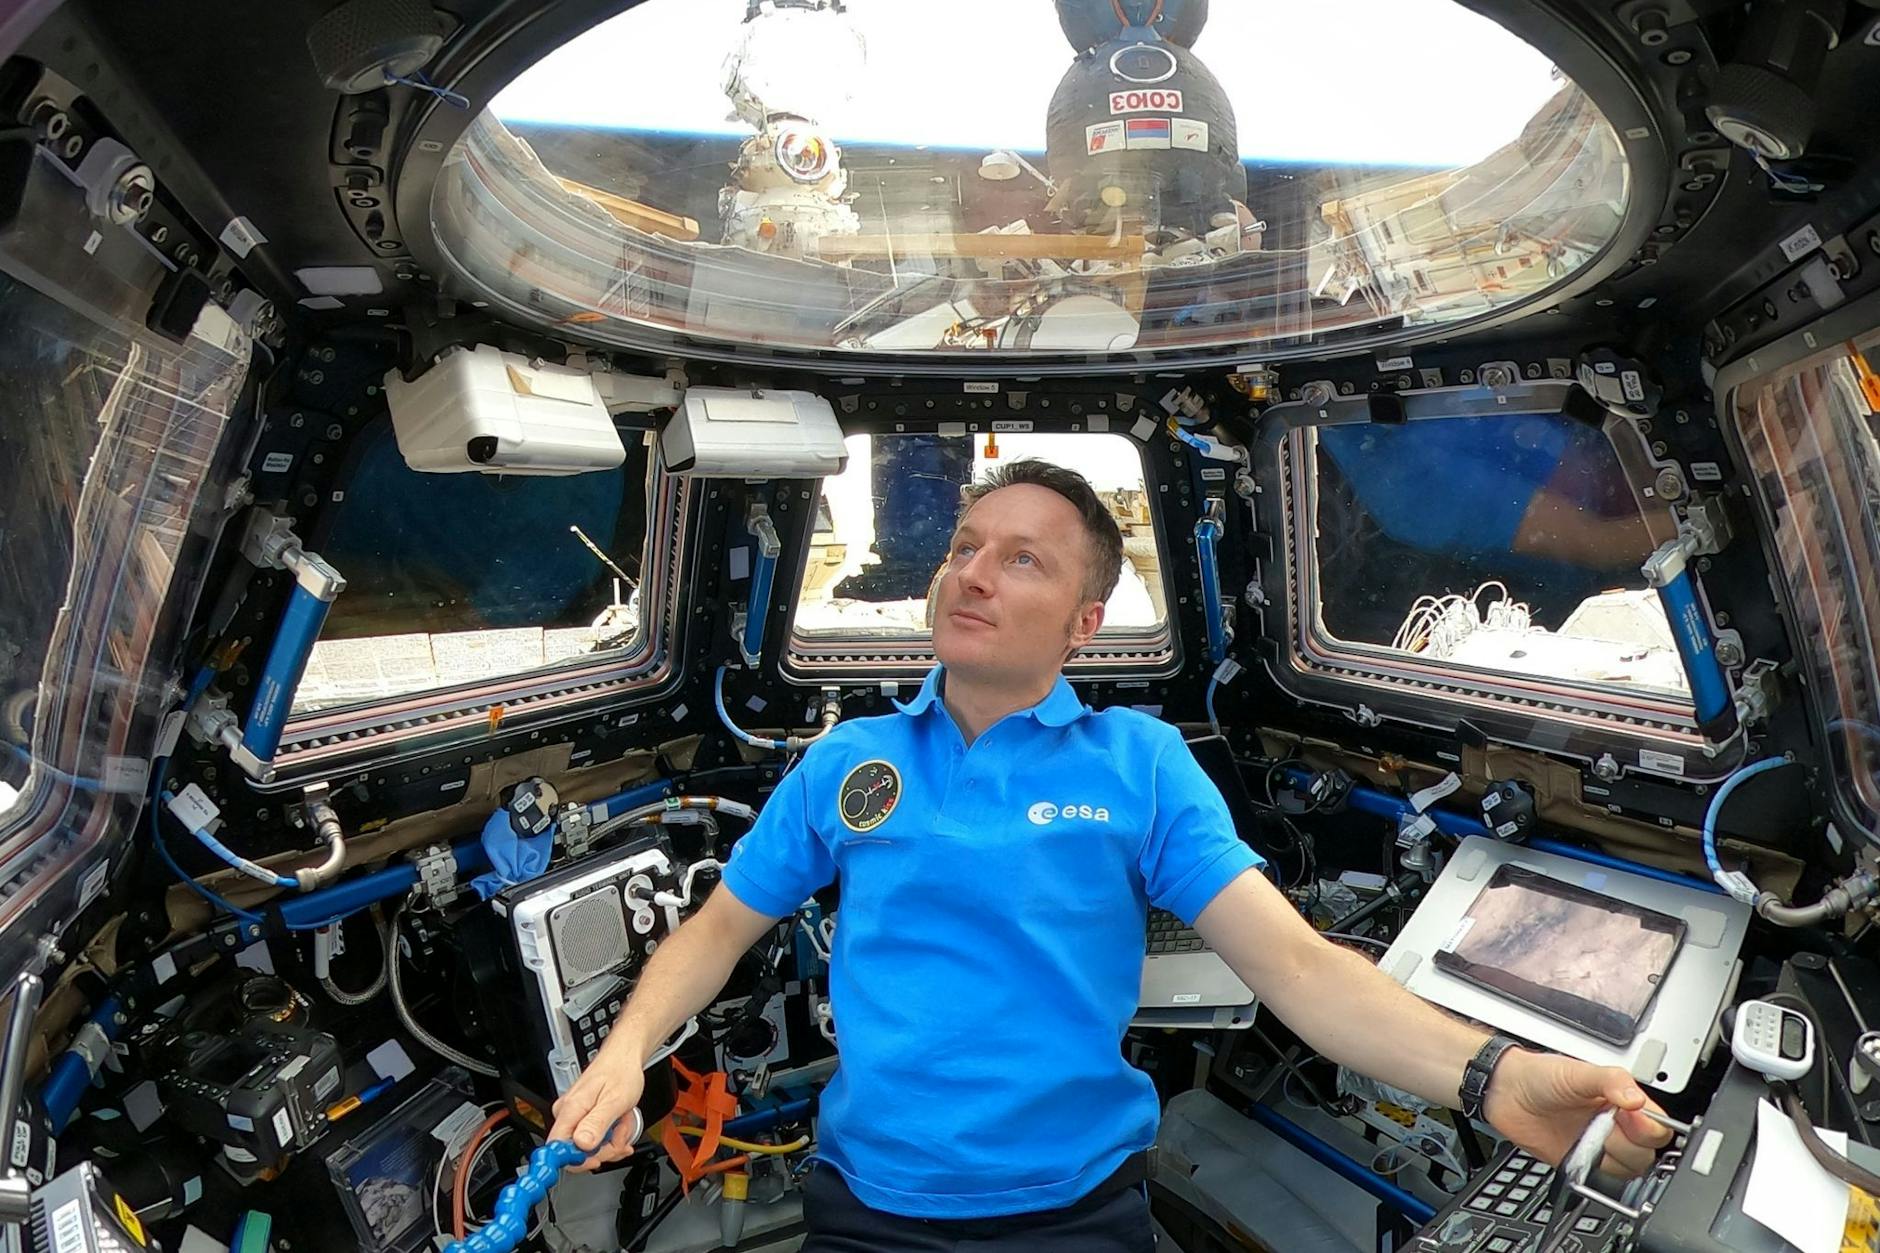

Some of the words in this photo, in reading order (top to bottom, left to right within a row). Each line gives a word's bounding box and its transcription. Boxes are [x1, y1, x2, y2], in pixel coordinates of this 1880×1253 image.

[1112, 91, 1181, 111] СОЮЗ
[858, 813, 882, 828] cosmic
[1062, 805, 1110, 822] esa
